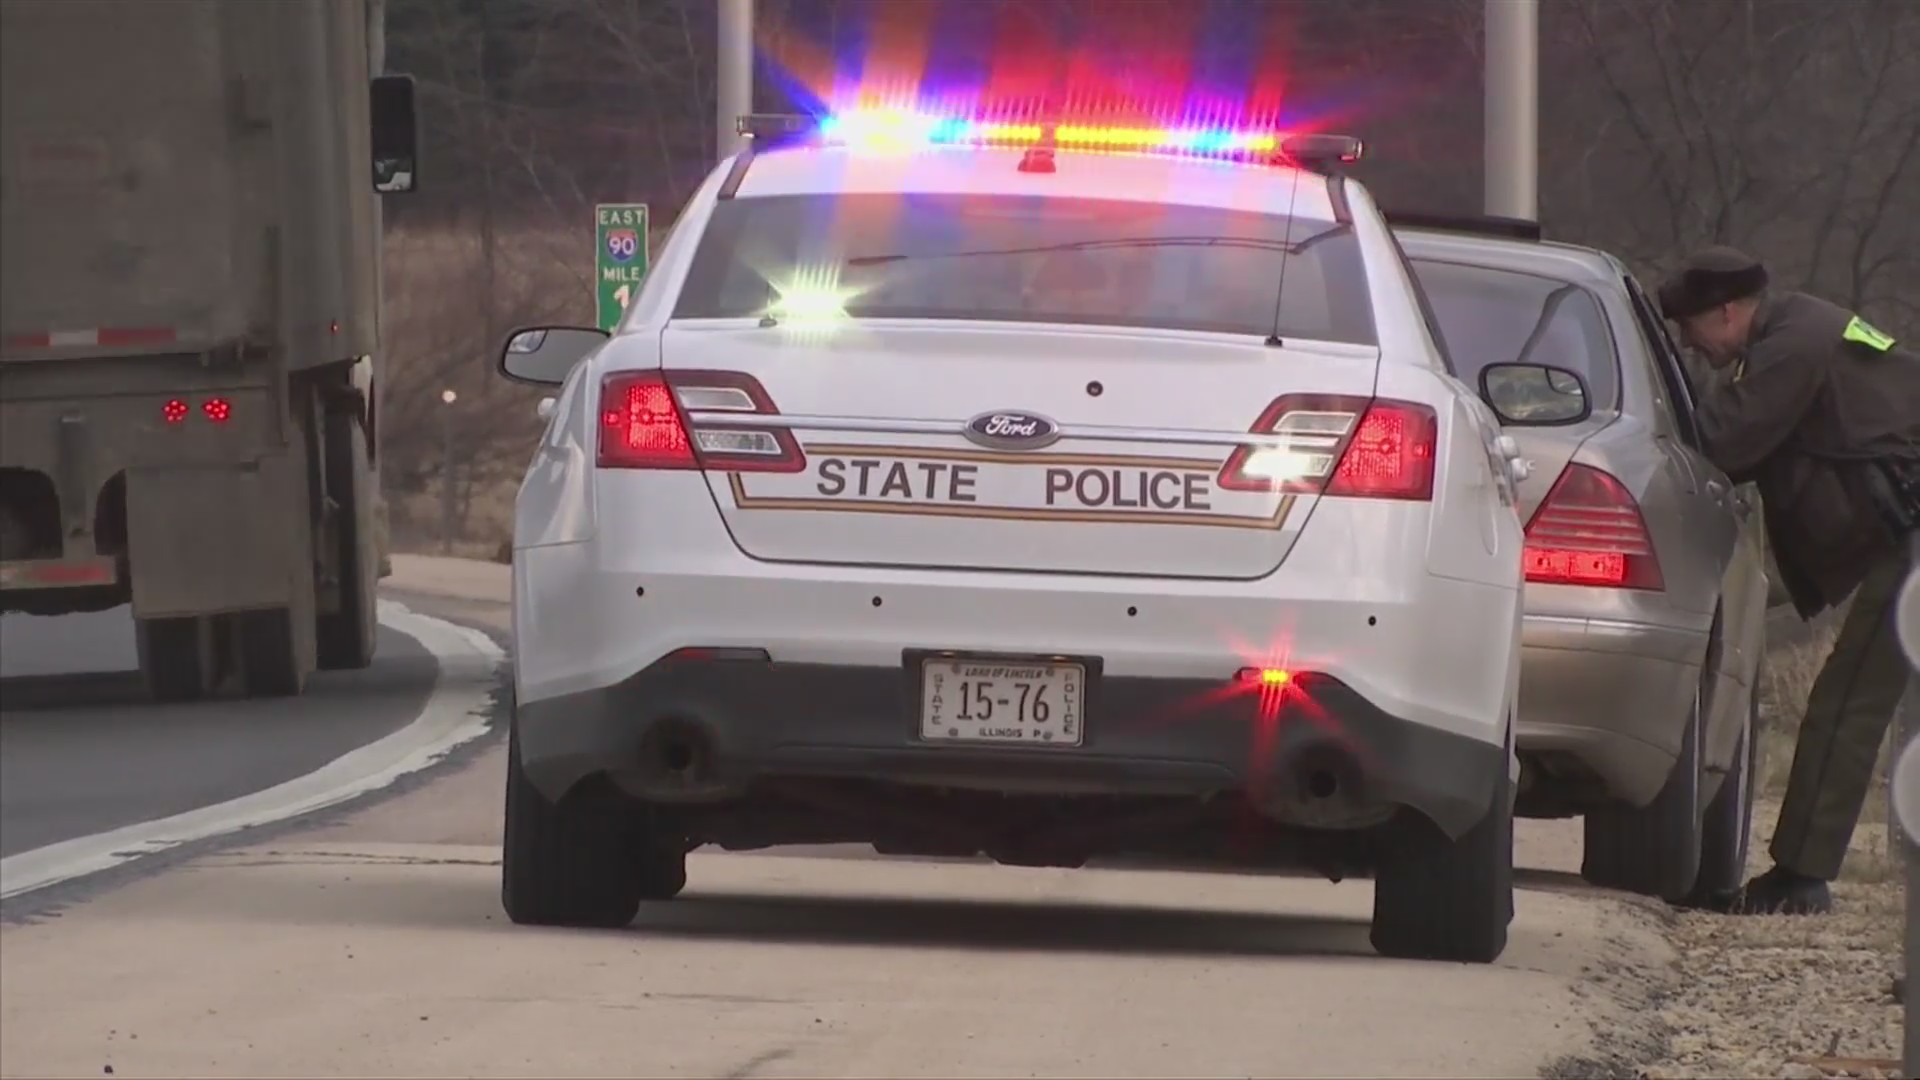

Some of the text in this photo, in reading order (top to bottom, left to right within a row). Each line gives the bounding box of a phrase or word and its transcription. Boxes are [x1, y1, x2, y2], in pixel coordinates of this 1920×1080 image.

[600, 210, 644, 225] EAST
[609, 237, 635, 255] 90
[603, 266, 641, 281] MILE
[985, 415, 1037, 436] Ford
[816, 458, 1211, 510] STATE POLICE
[956, 681, 1050, 723] 15-76
[978, 728, 1023, 738] ILLINOIS
